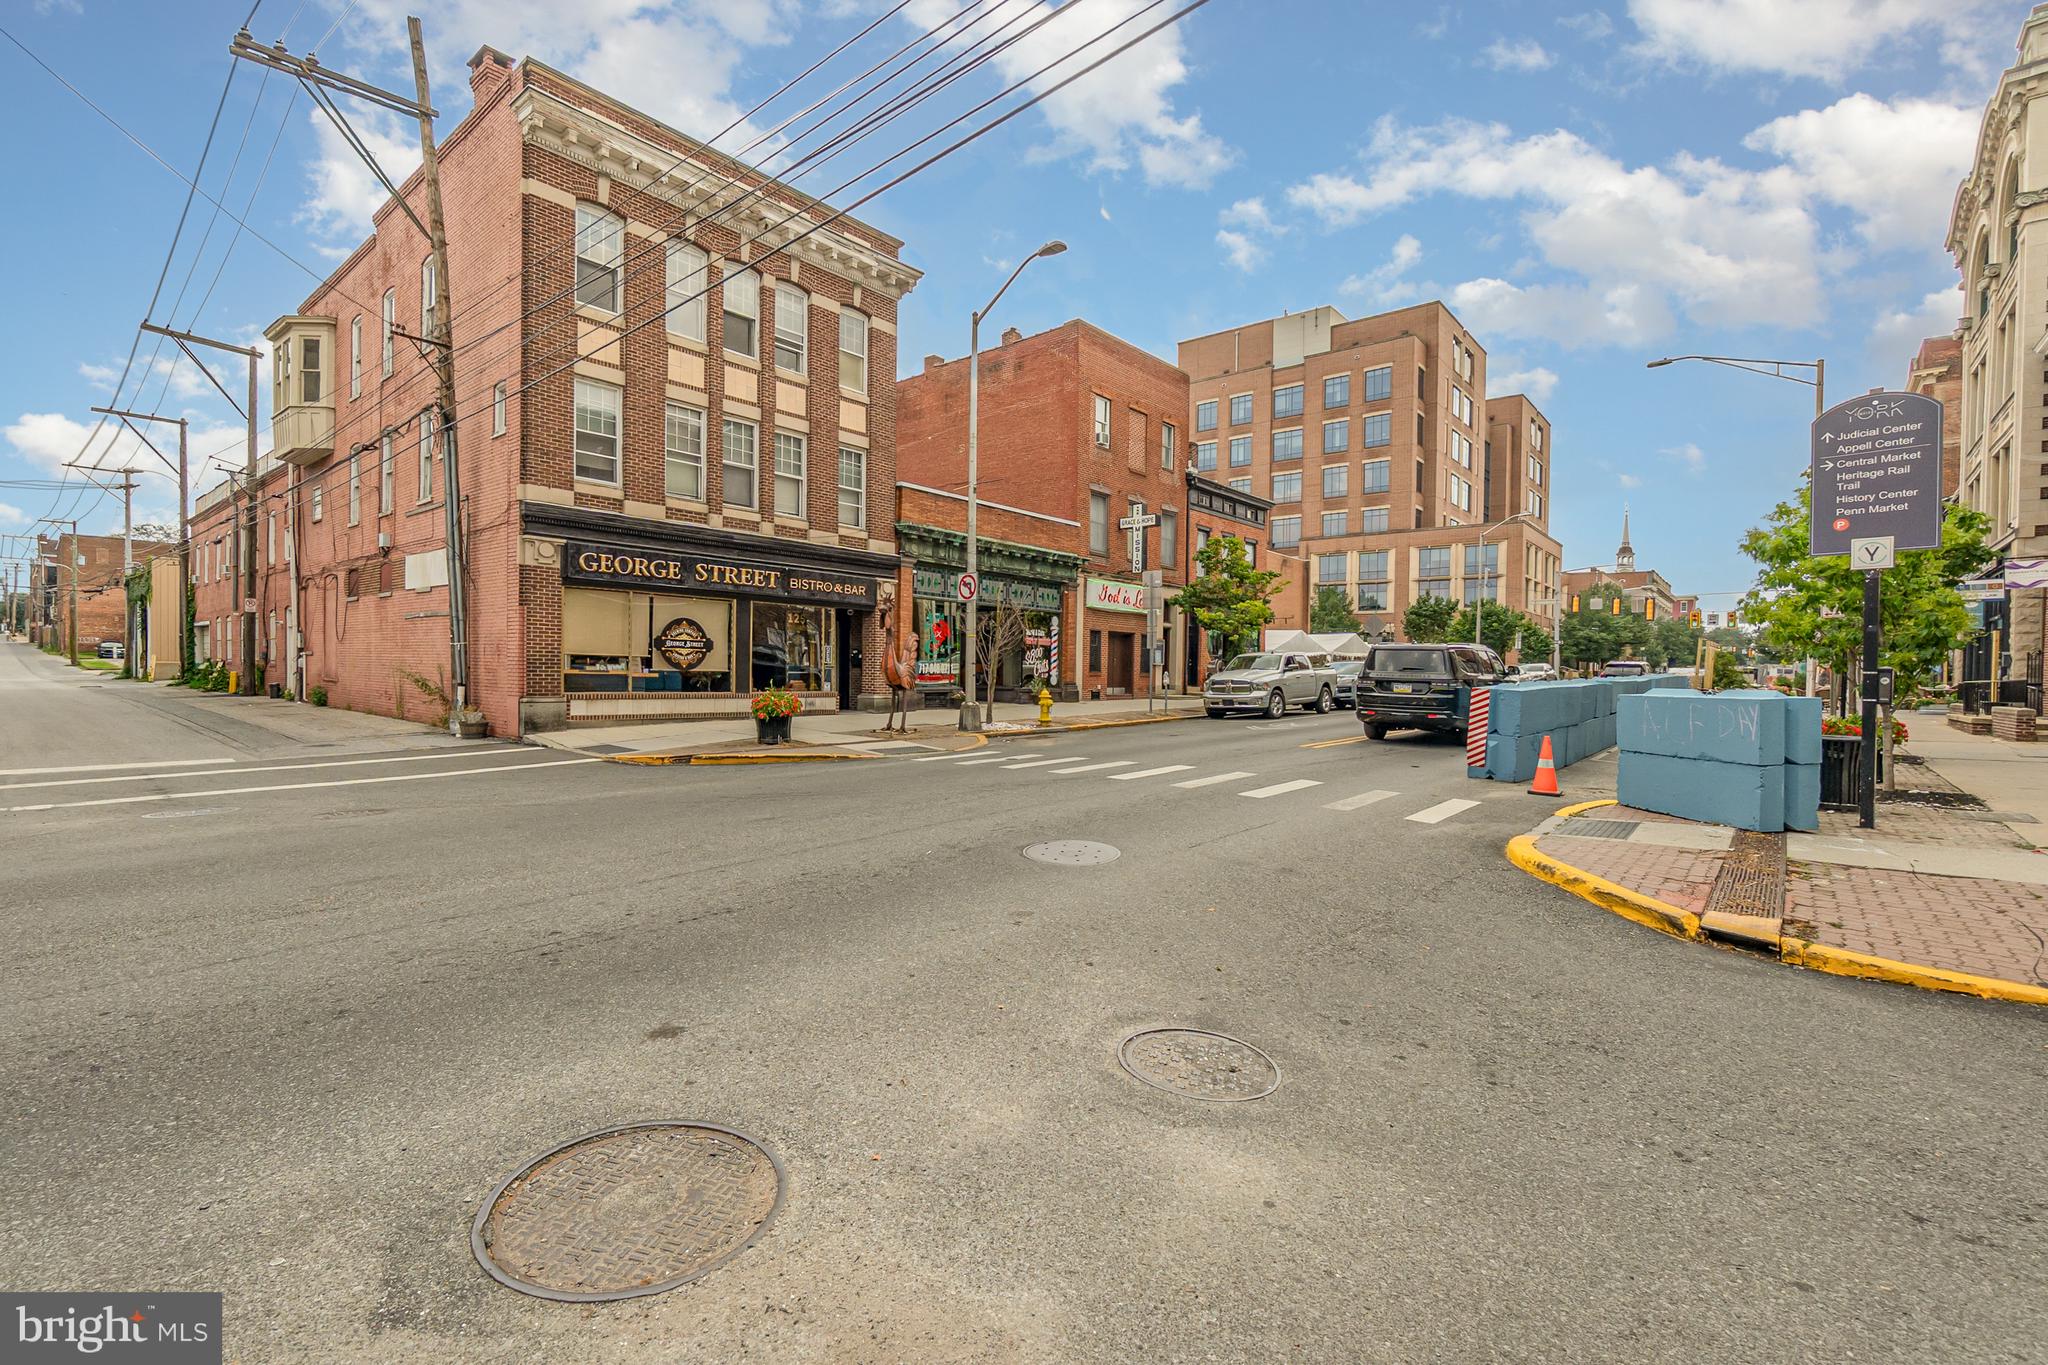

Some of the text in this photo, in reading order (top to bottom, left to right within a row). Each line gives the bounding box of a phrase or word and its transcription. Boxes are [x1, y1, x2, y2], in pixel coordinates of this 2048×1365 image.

[1845, 400, 1905, 422] YORK
[1837, 423, 1923, 440] Judicial Center
[1837, 437, 1915, 453] Appell Center
[1836, 451, 1921, 468] Central Market
[1836, 466, 1910, 481] Heritage Rail
[1836, 481, 1860, 491] Trail
[1836, 489, 1918, 503] History Center
[1836, 502, 1909, 516] Penn Market
[1836, 521, 1845, 529] P
[1864, 546, 1880, 561] Y
[578, 552, 682, 580] GEORGE
[695, 563, 781, 589] STREET
[789, 578, 832, 593] BISTRO
[844, 585, 866, 596] BAR
[1098, 584, 1121, 604] God
[1122, 590, 1131, 606] is
